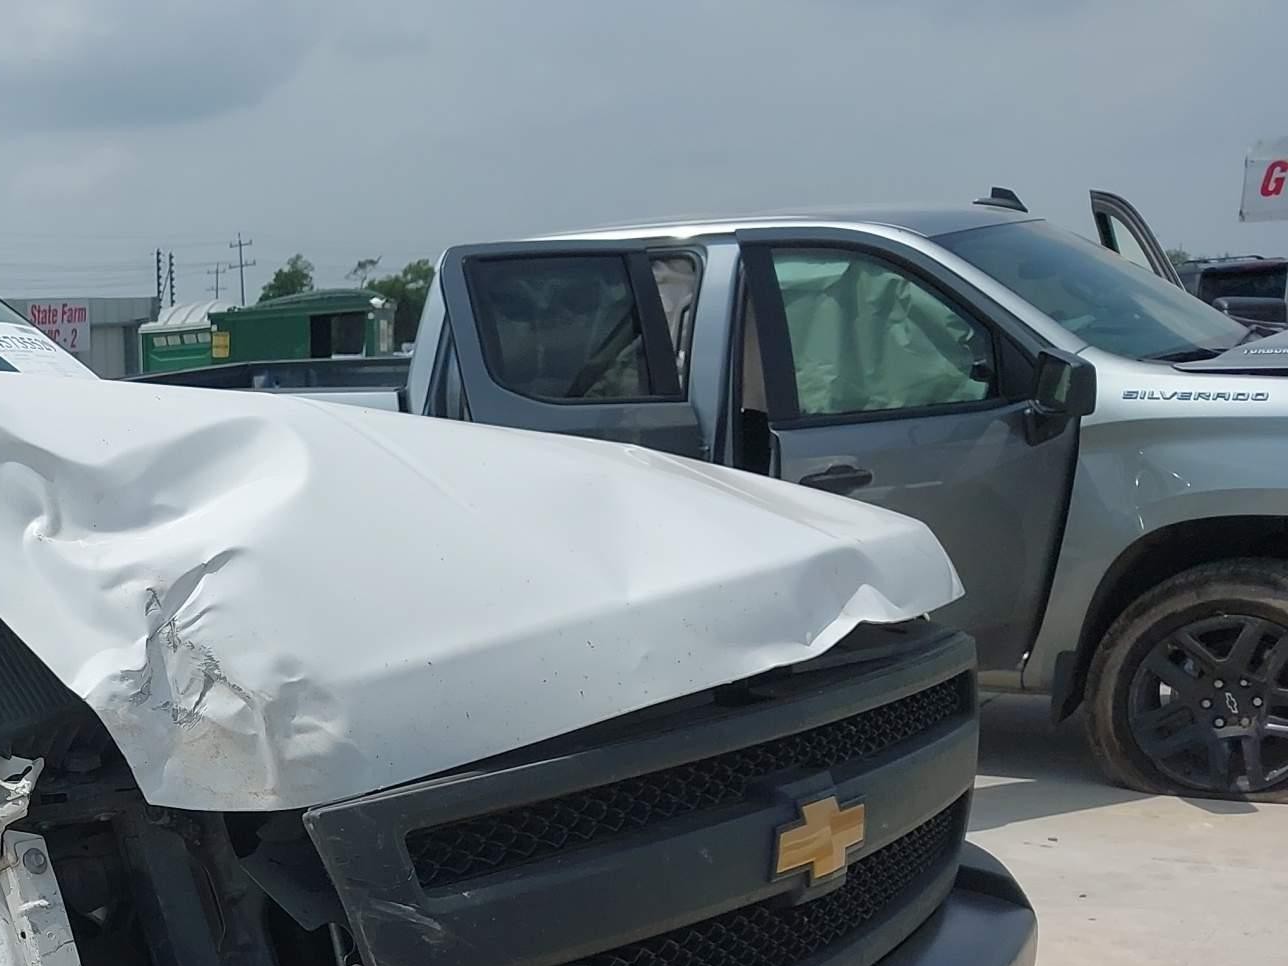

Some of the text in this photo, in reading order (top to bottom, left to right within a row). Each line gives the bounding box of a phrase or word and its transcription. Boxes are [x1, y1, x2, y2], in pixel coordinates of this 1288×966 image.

[31, 304, 86, 325] State Farm
[70, 328, 78, 349] 2
[1122, 389, 1270, 402] SILVERADO
